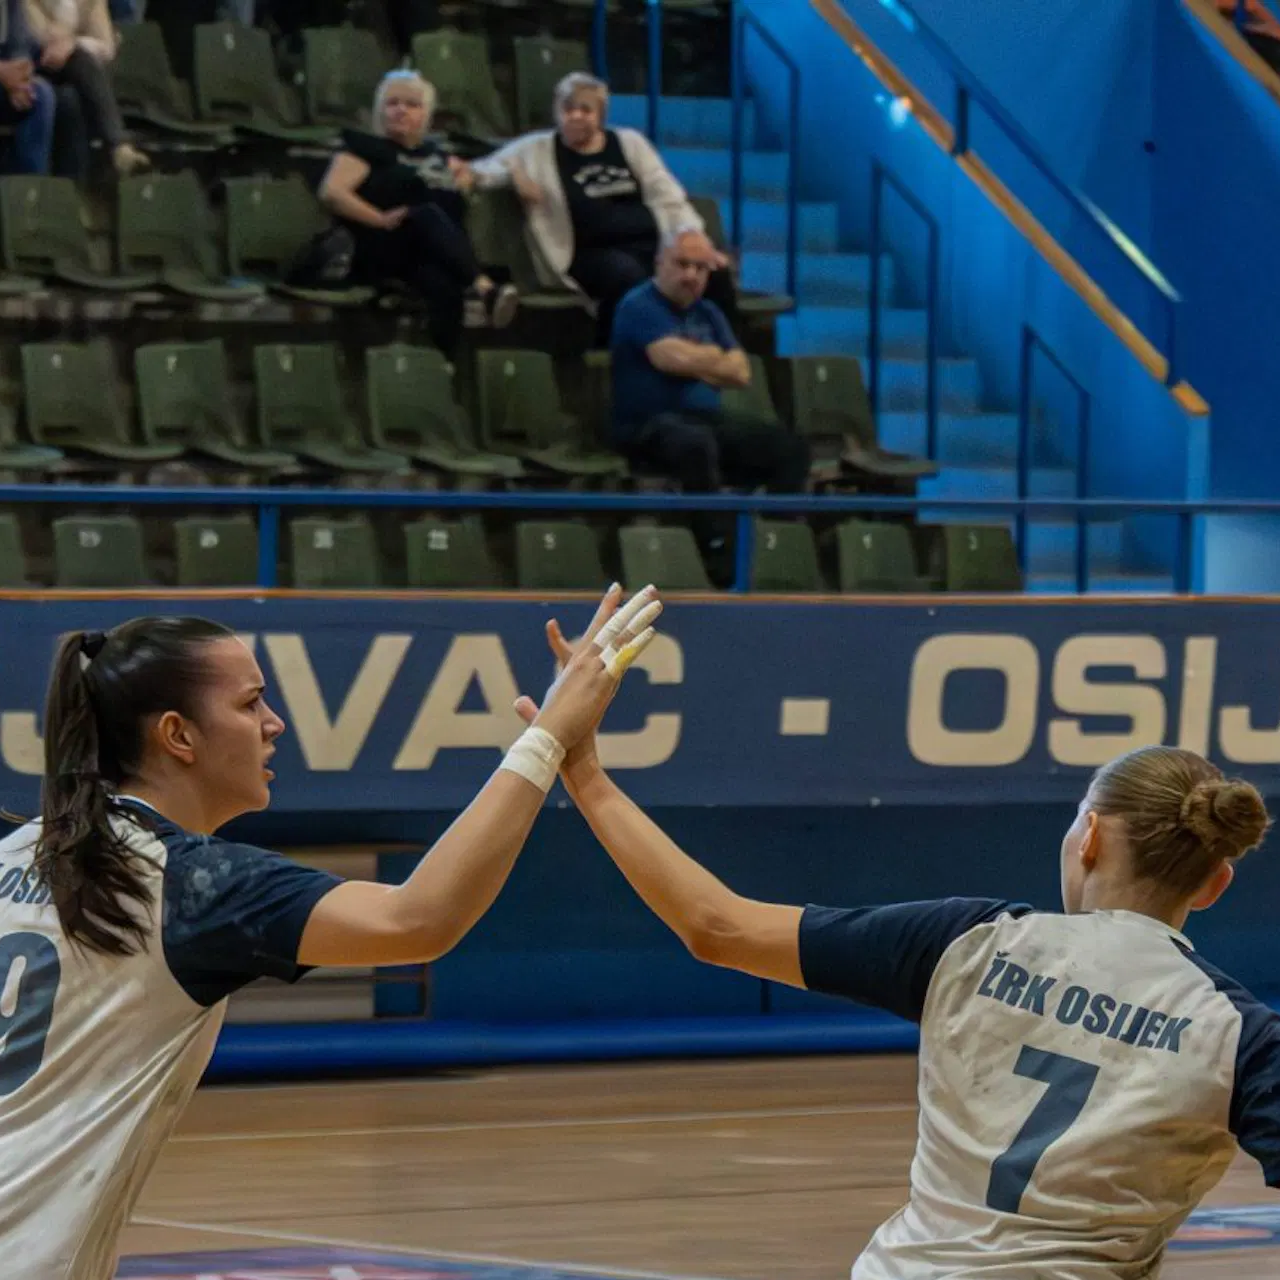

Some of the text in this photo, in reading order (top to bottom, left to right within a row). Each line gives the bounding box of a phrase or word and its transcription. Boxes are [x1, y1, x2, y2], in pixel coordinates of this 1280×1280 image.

[977, 950, 1193, 1054] ŽRK OSIJEK
[985, 1043, 1101, 1214] 7
